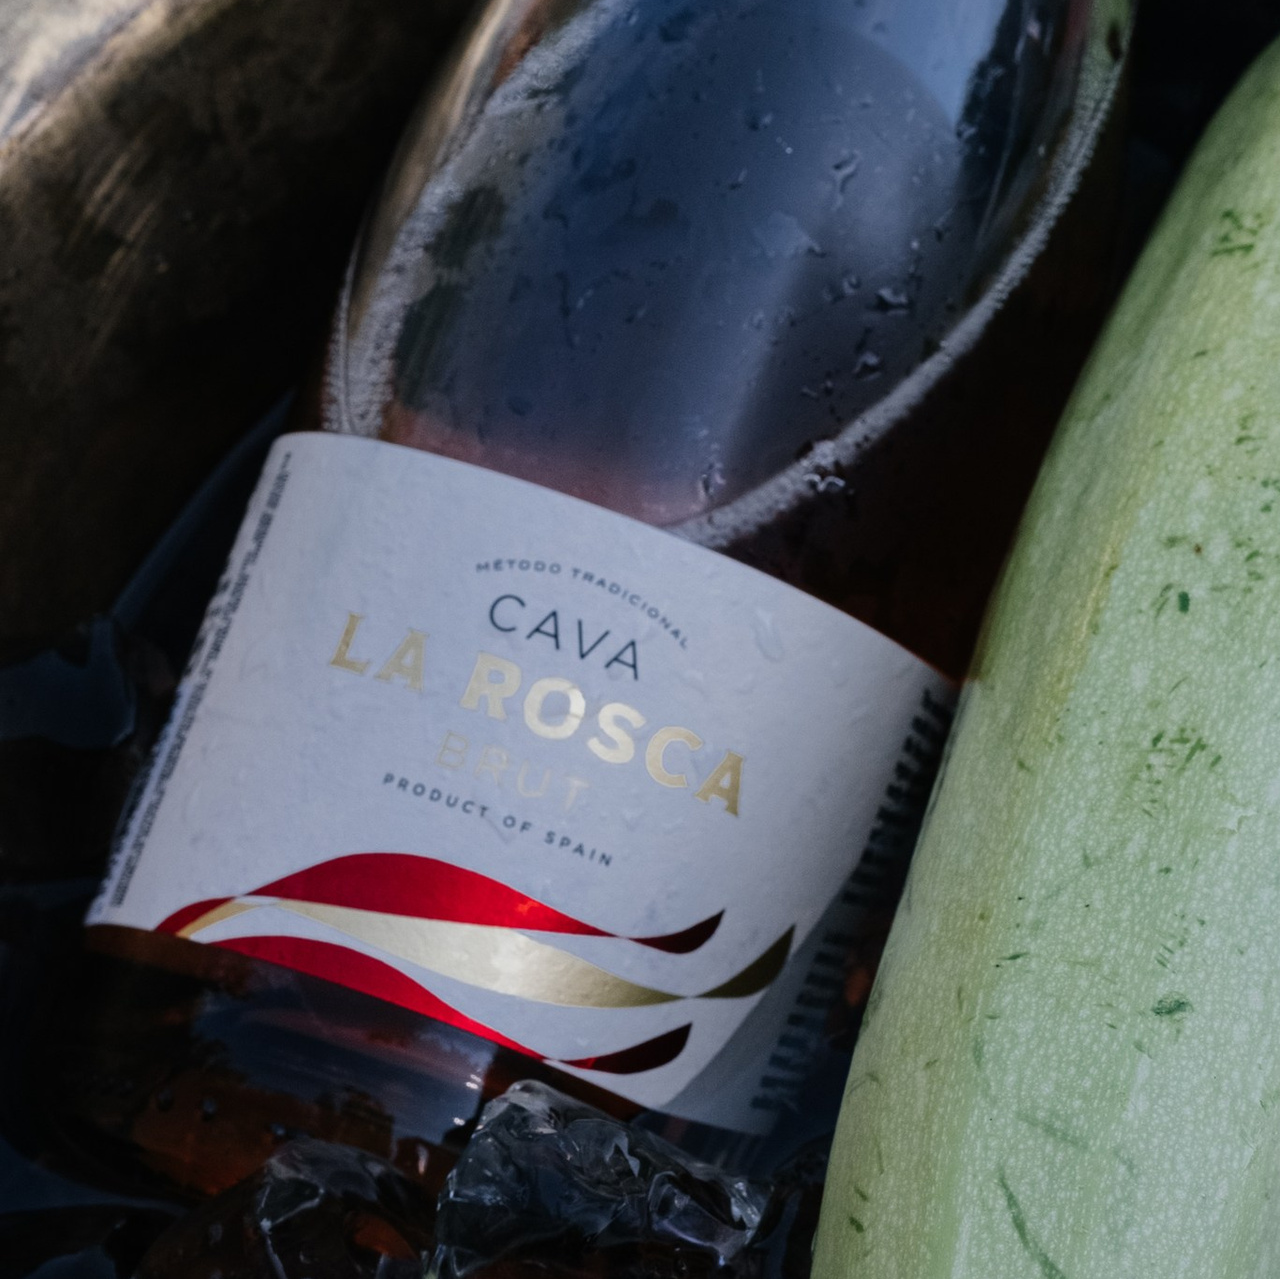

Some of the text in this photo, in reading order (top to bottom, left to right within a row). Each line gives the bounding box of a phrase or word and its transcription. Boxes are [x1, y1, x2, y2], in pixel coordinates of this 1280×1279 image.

[489, 594, 638, 680] CAVA
[571, 568, 688, 650] TRADICIONAL
[329, 611, 745, 817] LA ROSCA
[436, 730, 589, 811] BRUT
[383, 773, 613, 866] PRODUCT OF SPAIN
